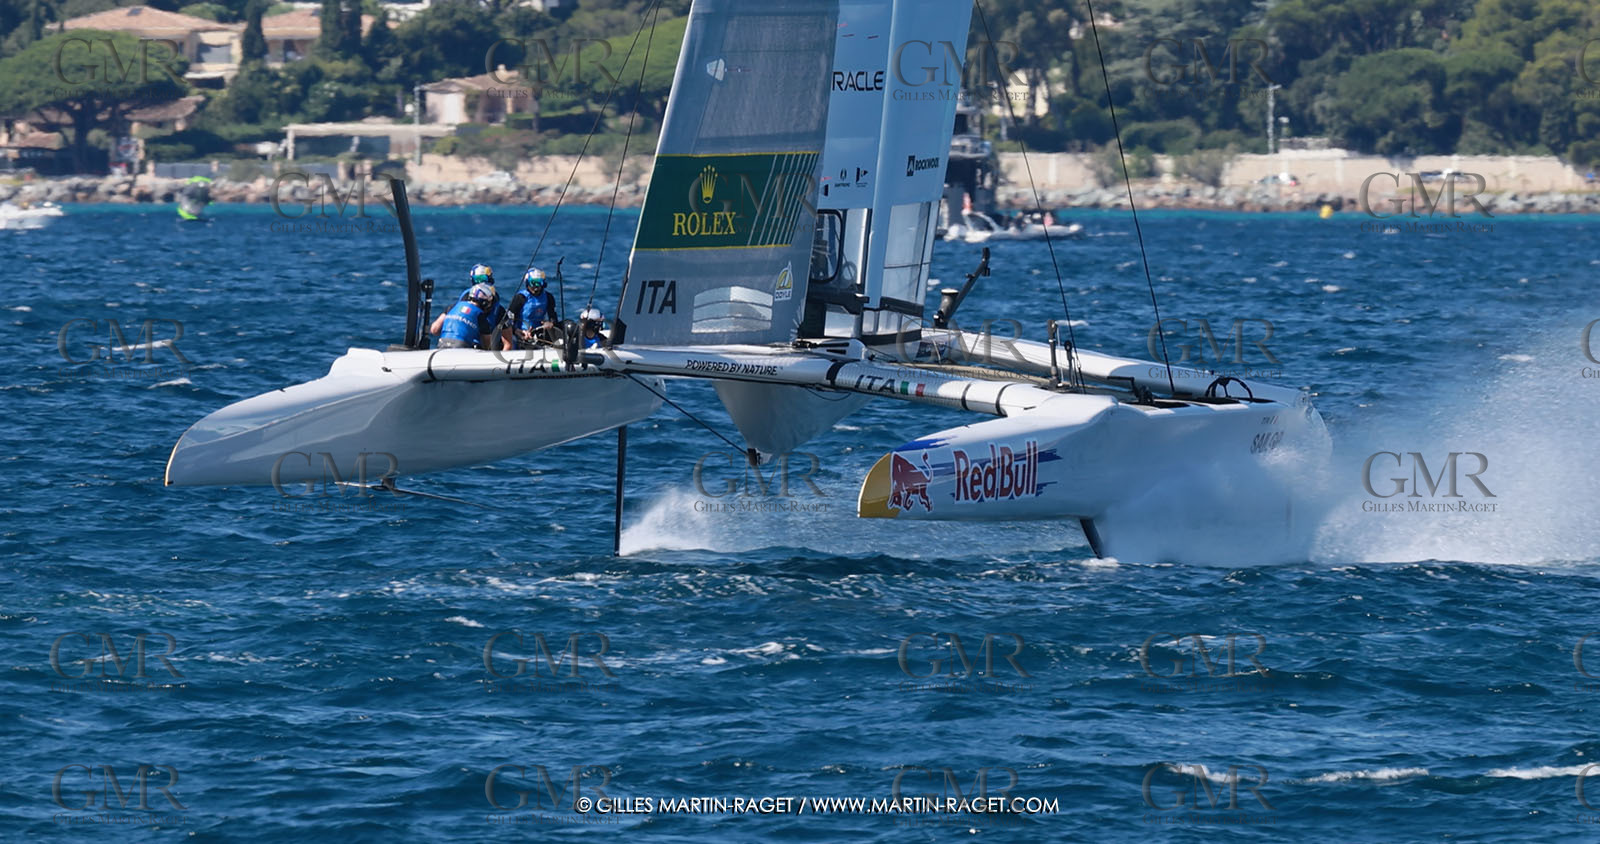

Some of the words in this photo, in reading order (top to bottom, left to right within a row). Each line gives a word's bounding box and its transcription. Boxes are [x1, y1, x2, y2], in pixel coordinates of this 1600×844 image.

[832, 71, 884, 91] RACLE
[672, 211, 736, 236] ROLEX
[635, 280, 677, 315] ITA
[505, 359, 547, 374] ITA
[685, 359, 729, 372] POWERED
[728, 363, 742, 373] BY
[855, 374, 895, 394] ITA
[953, 443, 998, 502] Red
[999, 440, 1038, 498] Bull
